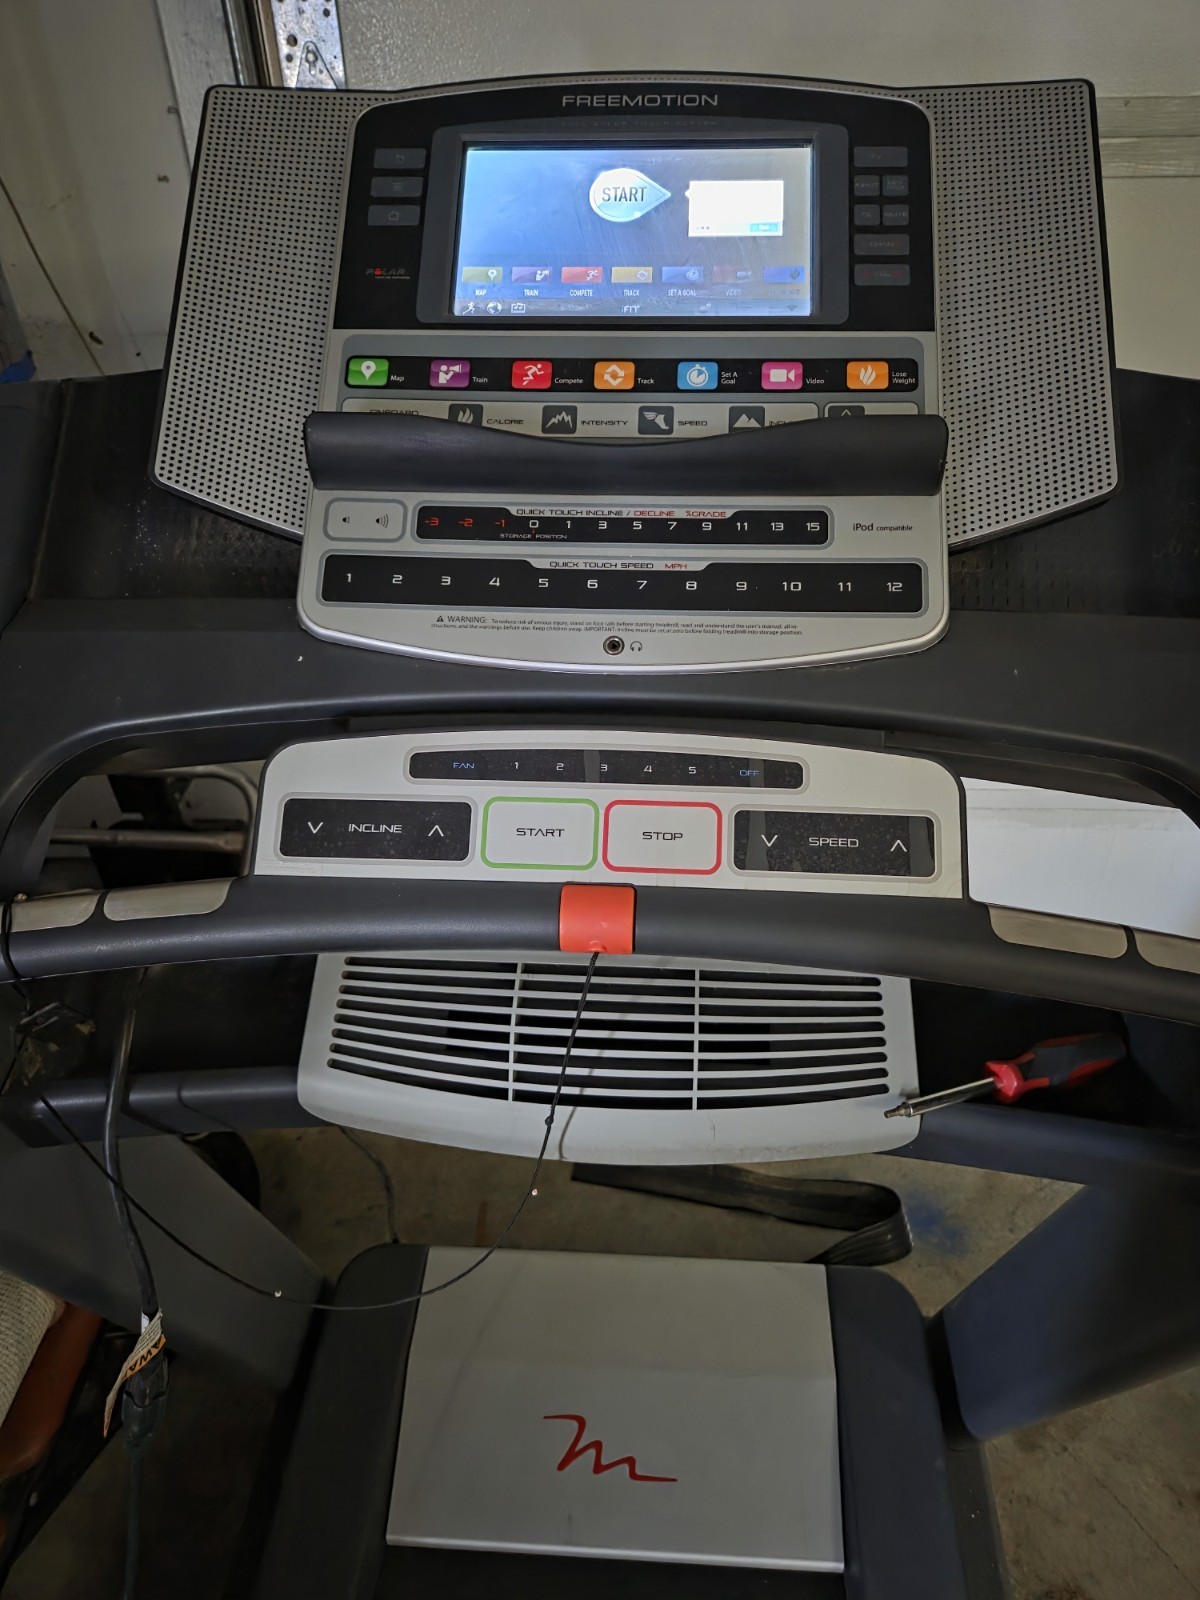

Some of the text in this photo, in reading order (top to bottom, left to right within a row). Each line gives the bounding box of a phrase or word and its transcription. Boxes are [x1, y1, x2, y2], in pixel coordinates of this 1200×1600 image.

[562, 94, 719, 107] FREEMOTION
[602, 186, 647, 202] START
[475, 289, 487, 297] MAP
[524, 289, 539, 297] TRAIN
[569, 289, 593, 297] COMPETE
[623, 289, 640, 297] TRACK
[390, 374, 405, 383] Map
[554, 377, 583, 385] Compete
[637, 377, 655, 385] Track
[805, 377, 825, 385] Video
[892, 377, 916, 385] Weight
[685, 510, 727, 518] %GRADE
[424, 517, 820, 531] -3 -2 -1 0 1 3 5 7 9 11 13 15
[853, 523, 913, 532] iPod compatible
[347, 573, 903, 592] 1 2 3 4 5 6 7 8 9 10 11 12
[447, 615, 488, 624] WARNING:
[514, 762, 519, 770] 1
[556, 763, 565, 771] 2
[600, 763, 608, 771] 3
[644, 765, 653, 773] 4
[688, 767, 697, 775] 5
[739, 769, 760, 777] OFF
[348, 823, 403, 834] INCLINE
[516, 827, 565, 838] START
[642, 831, 683, 841] STOP
[808, 837, 859, 848] SPEED
